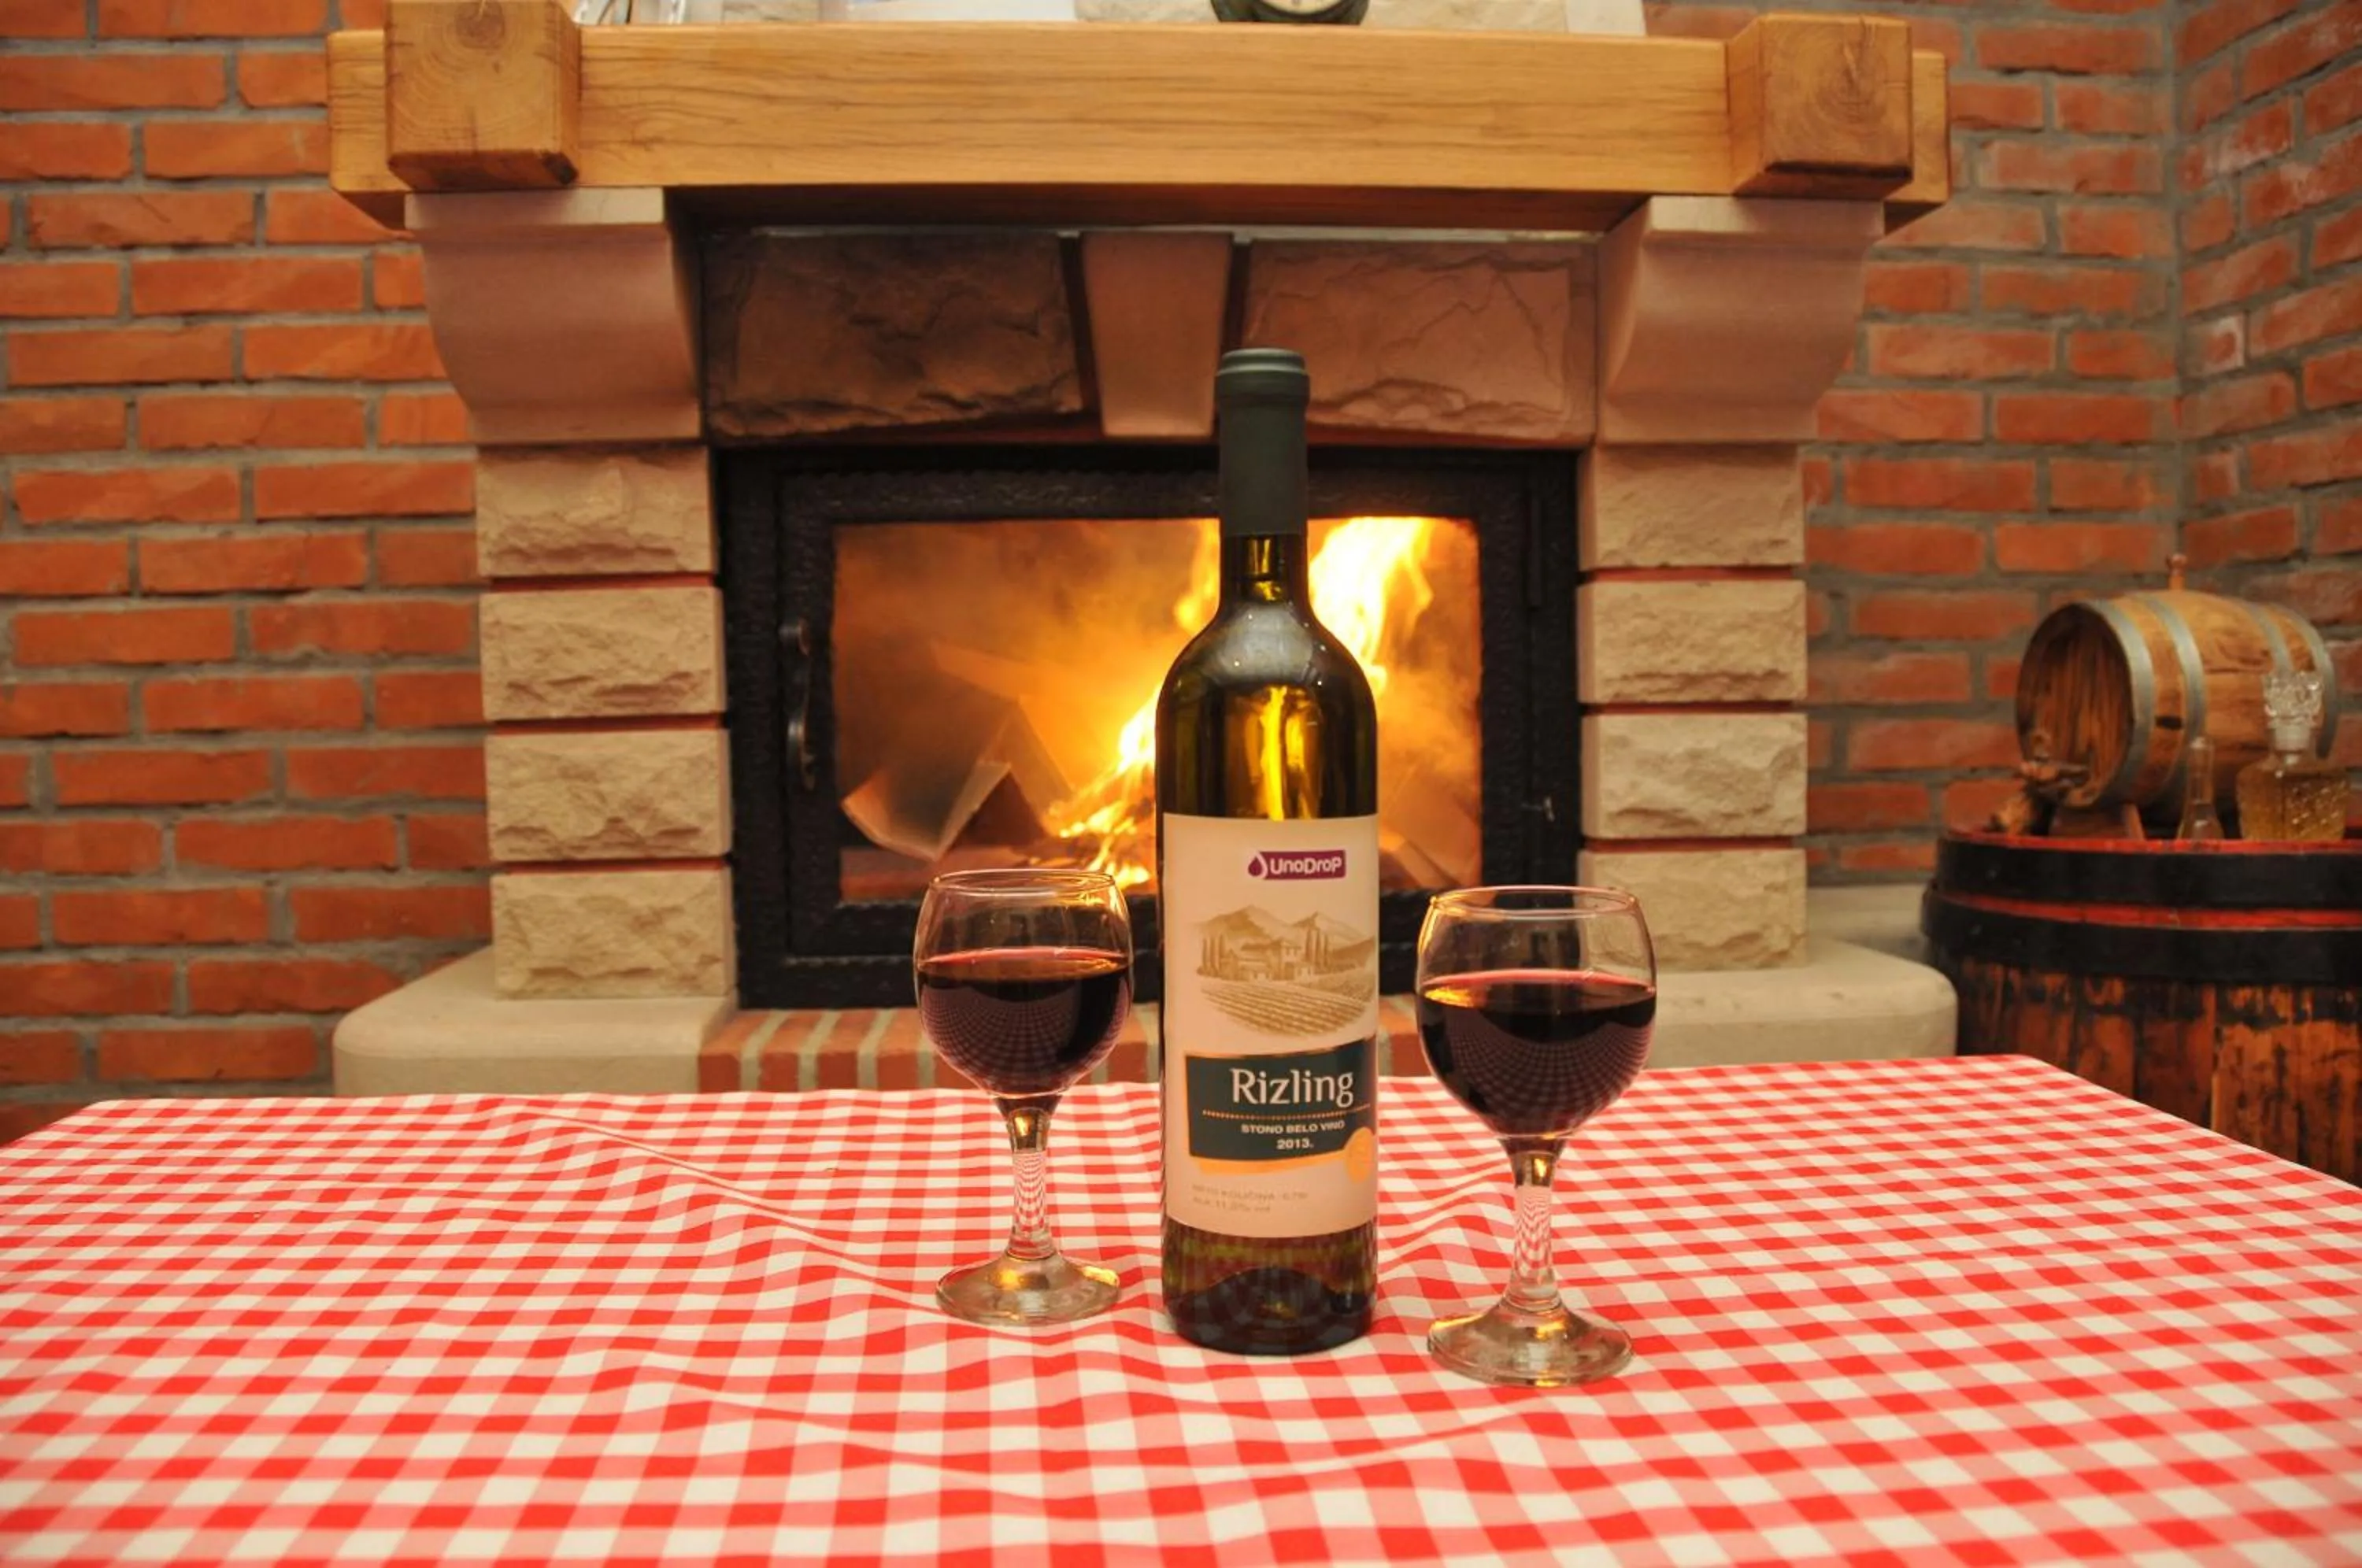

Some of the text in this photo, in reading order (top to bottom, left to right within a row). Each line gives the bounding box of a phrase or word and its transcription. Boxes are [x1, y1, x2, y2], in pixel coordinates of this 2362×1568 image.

[1230, 1067, 1354, 1108] Rizling
[1241, 1119, 1346, 1134] STONO BELO VINO
[1276, 1137, 1314, 1149] 2013.
